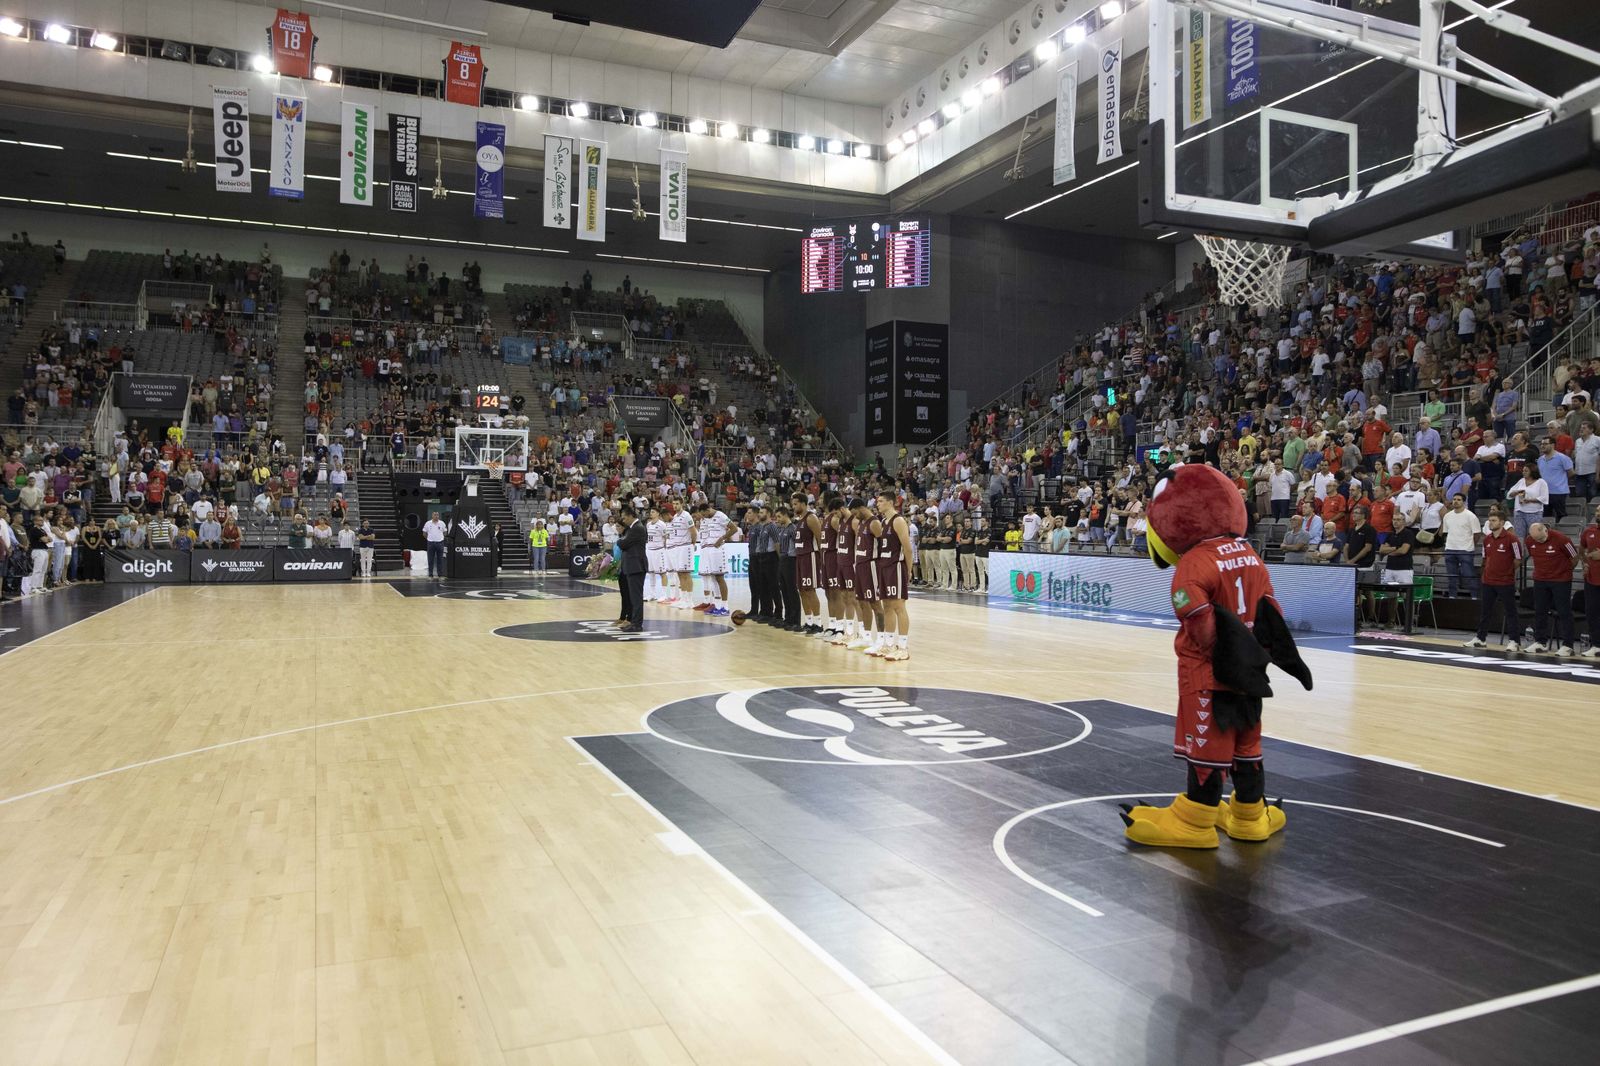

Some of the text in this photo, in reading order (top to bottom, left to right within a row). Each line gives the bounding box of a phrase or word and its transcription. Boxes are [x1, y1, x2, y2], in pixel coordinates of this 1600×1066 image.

[281, 22, 304, 31] PULEVA
[284, 30, 300, 49] 18
[455, 54, 476, 63] PULEVA
[460, 62, 470, 80] 8
[1193, 43, 1203, 121] ALHAMBRA
[1103, 74, 1116, 158] emasagra
[216, 101, 248, 177] Jeep
[396, 116, 406, 163] DE VERDAD
[405, 116, 417, 177] BURGERS
[354, 108, 368, 201] COVIRAN
[481, 152, 499, 161] OYA
[217, 179, 250, 187] MotorDOS
[668, 172, 680, 221] OLIVA
[588, 190, 598, 231] ALHAMBRA
[855, 264, 874, 275] 10:00
[130, 382, 177, 390] AYUNTAMIENTO
[143, 388, 173, 396] GRANADA
[482, 396, 498, 408] 24
[1216, 541, 1247, 556] FELIX
[122, 559, 173, 578] alight
[219, 560, 265, 569] CAJA RURAL
[1215, 556, 1260, 573] PULEVA
[802, 577, 812, 587] 20
[828, 577, 838, 587] 33
[1048, 570, 1112, 608] fertisac
[886, 586, 897, 596] 30
[1235, 576, 1247, 615] 1
[814, 686, 1008, 754] PULEVA
